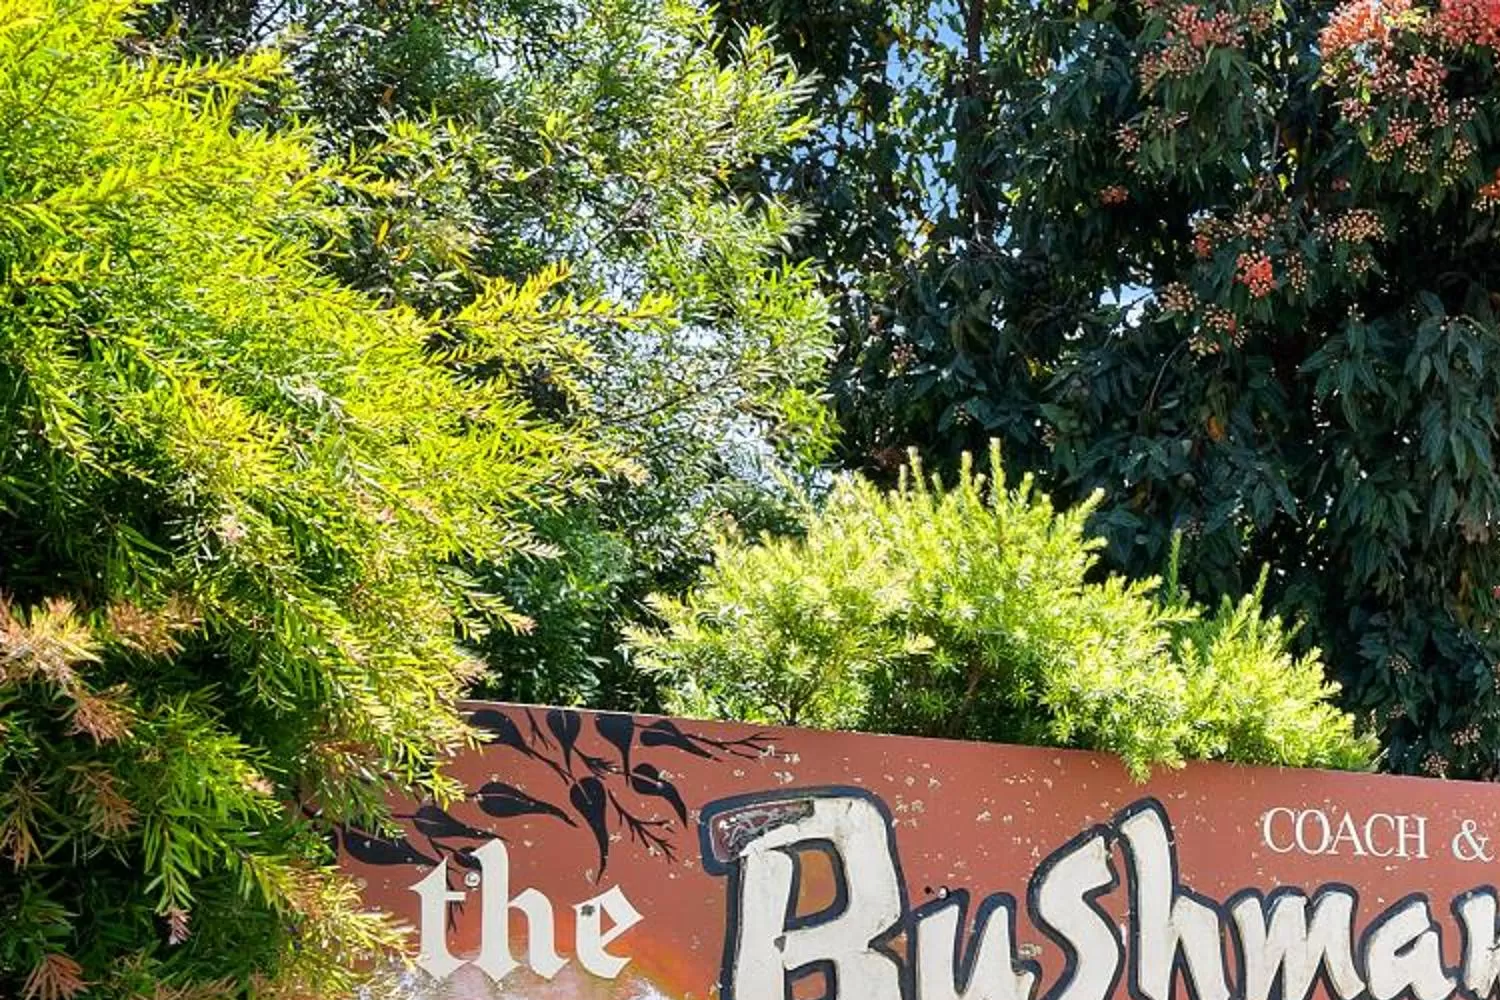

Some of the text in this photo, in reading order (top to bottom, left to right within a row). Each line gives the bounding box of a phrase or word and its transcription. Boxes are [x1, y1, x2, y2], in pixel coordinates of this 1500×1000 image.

[1263, 807, 1495, 863] COACH &
[410, 837, 644, 982] the
